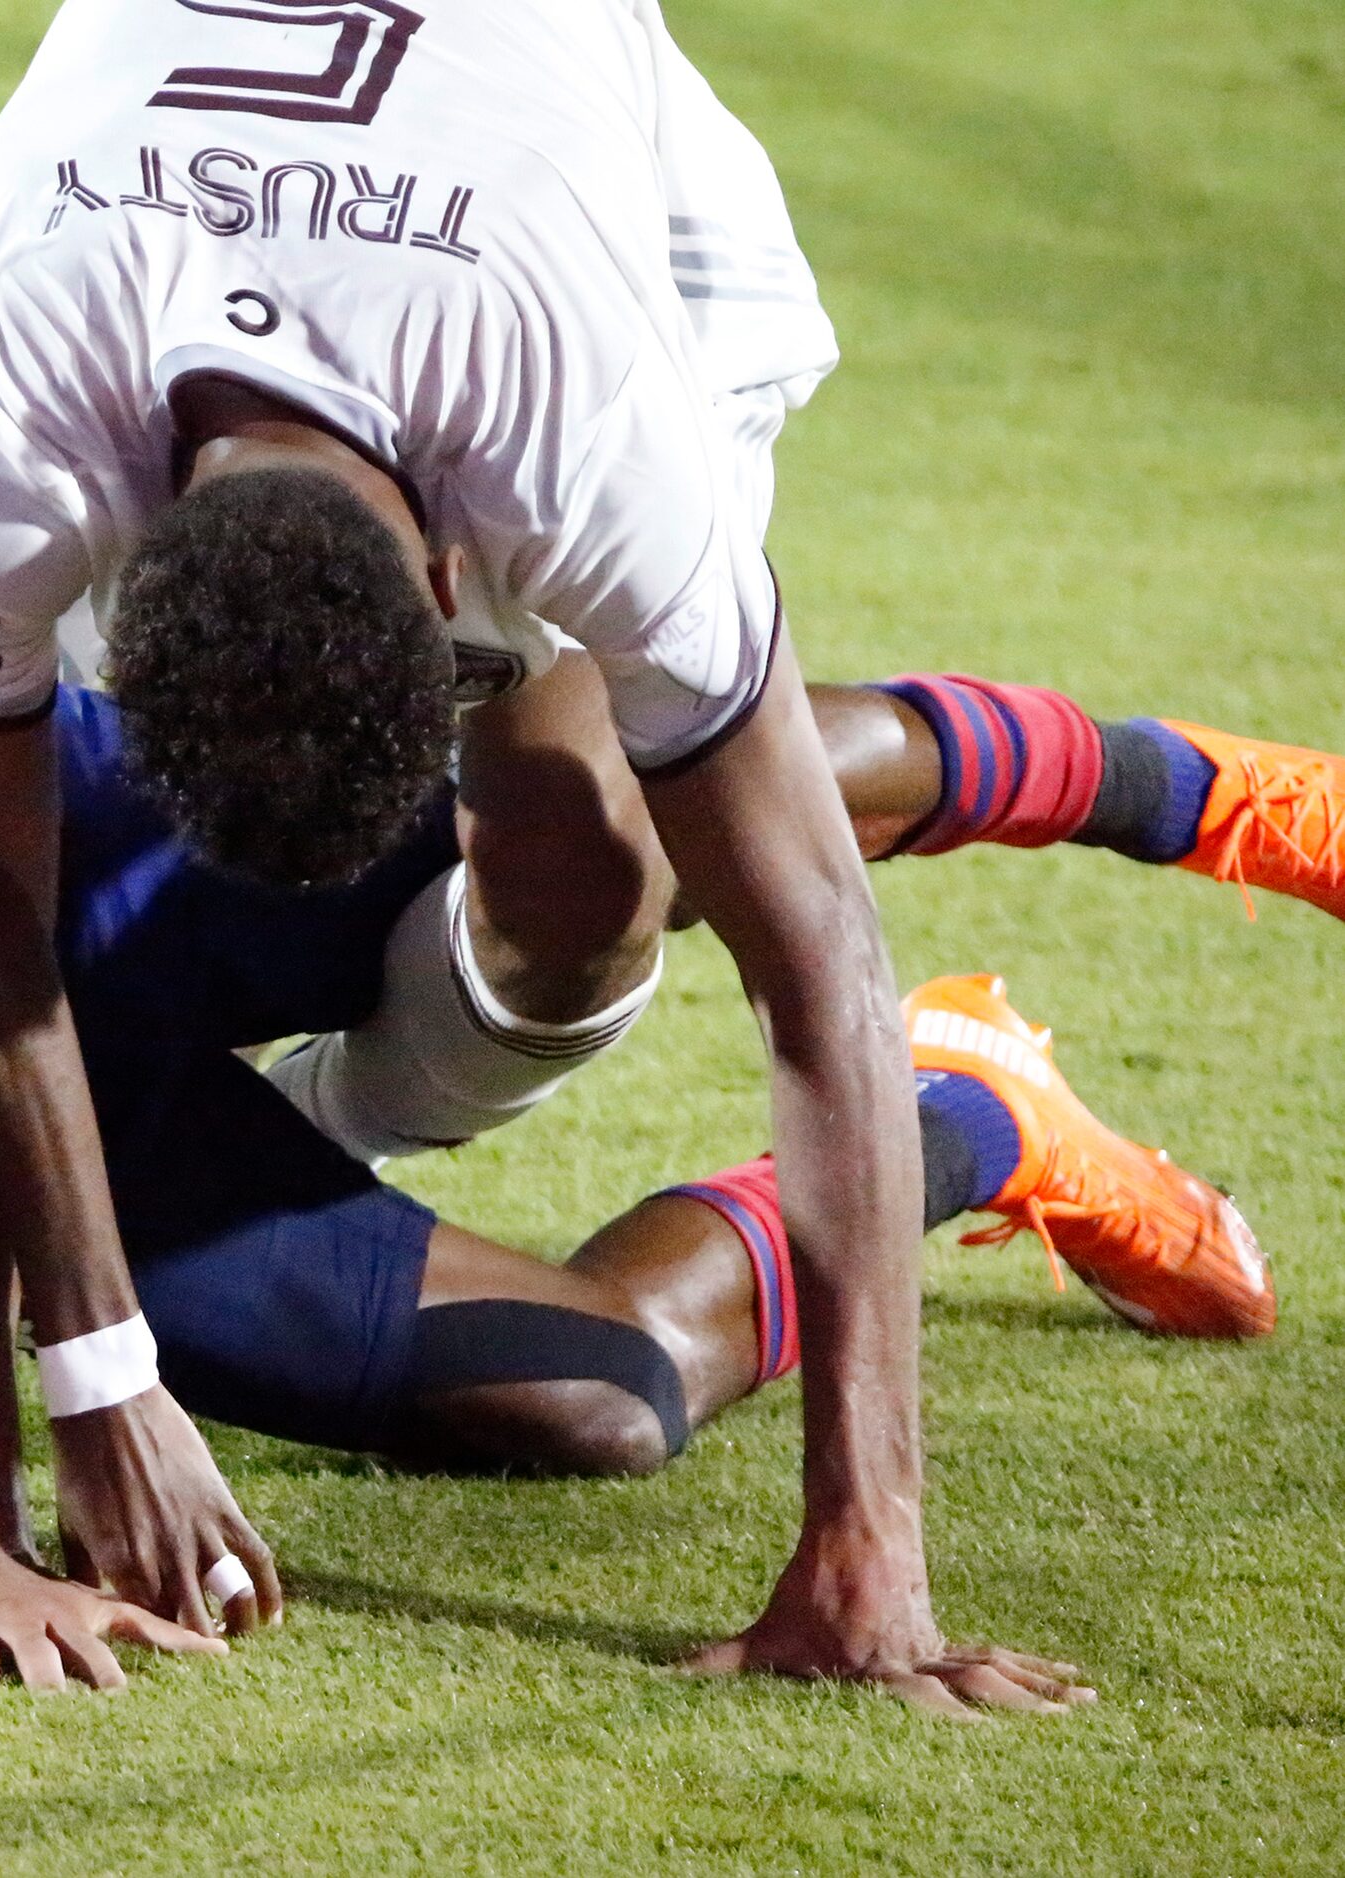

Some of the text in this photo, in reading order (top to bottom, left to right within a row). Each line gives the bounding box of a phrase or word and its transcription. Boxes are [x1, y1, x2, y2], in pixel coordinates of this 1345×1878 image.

[44, 145, 481, 265] TRUSTY
[225, 288, 280, 336] C
[657, 603, 706, 656] MLS
